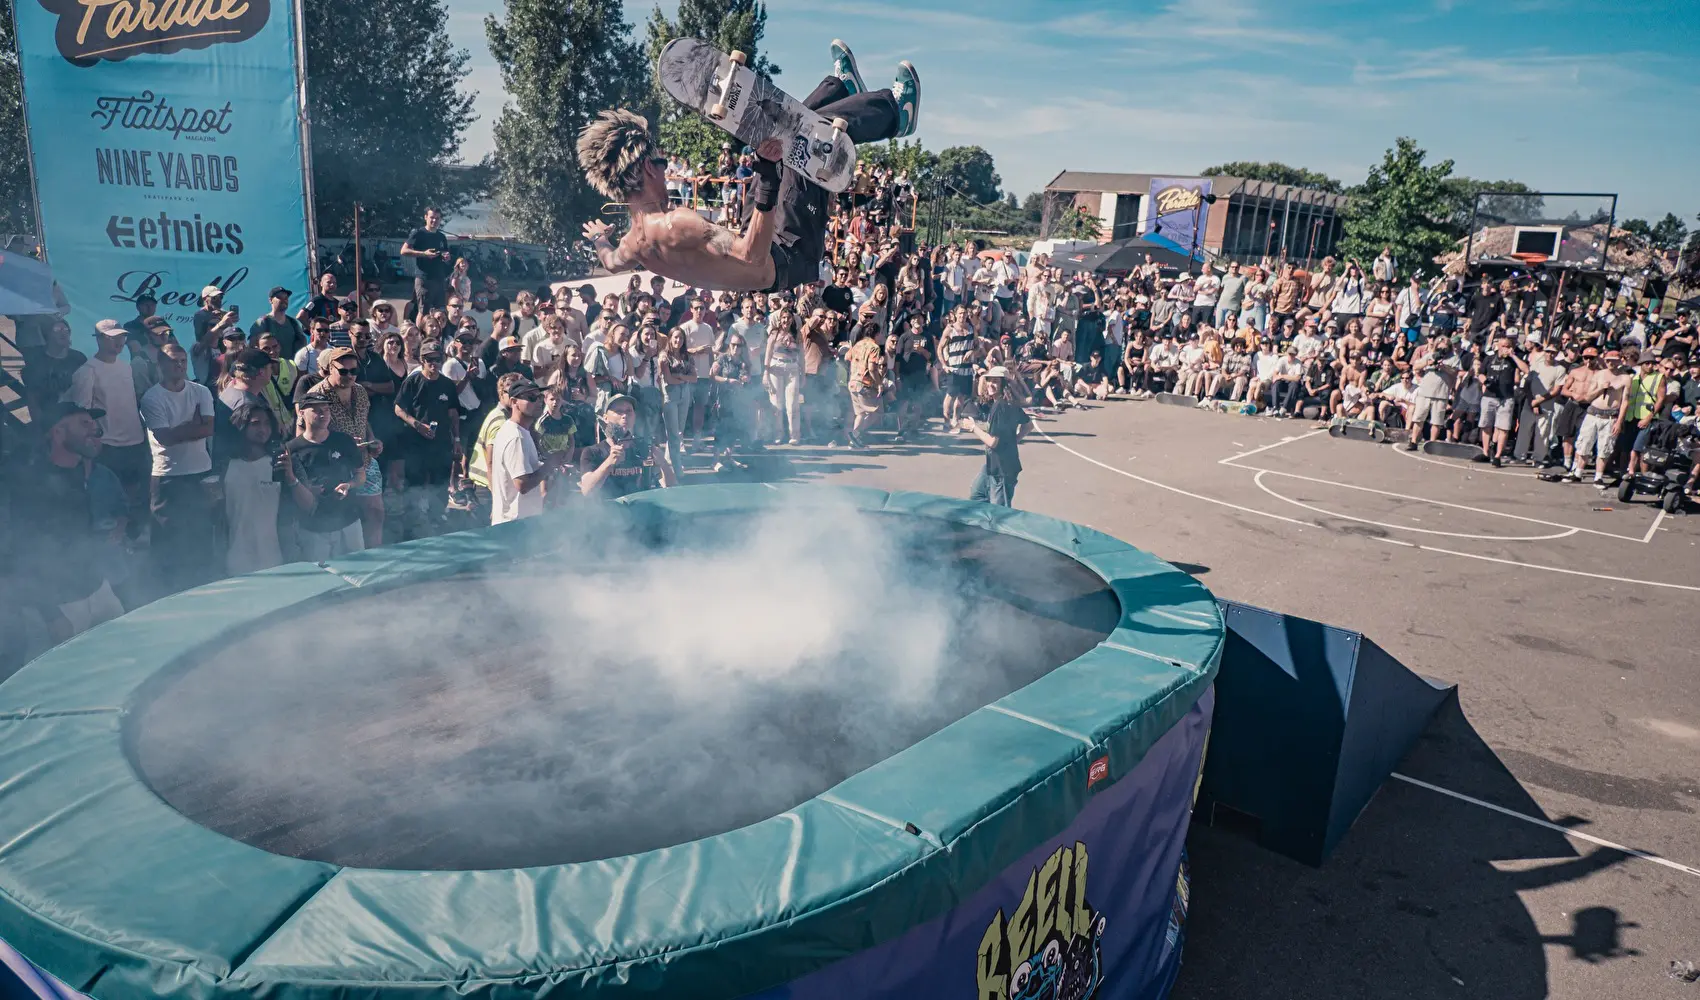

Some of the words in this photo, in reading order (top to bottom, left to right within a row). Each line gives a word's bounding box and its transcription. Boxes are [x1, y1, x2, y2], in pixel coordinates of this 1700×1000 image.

[91, 90, 233, 140] Flatspot
[95, 148, 155, 188] NINE
[157, 152, 239, 192] YARDS
[138, 211, 244, 254] etnies
